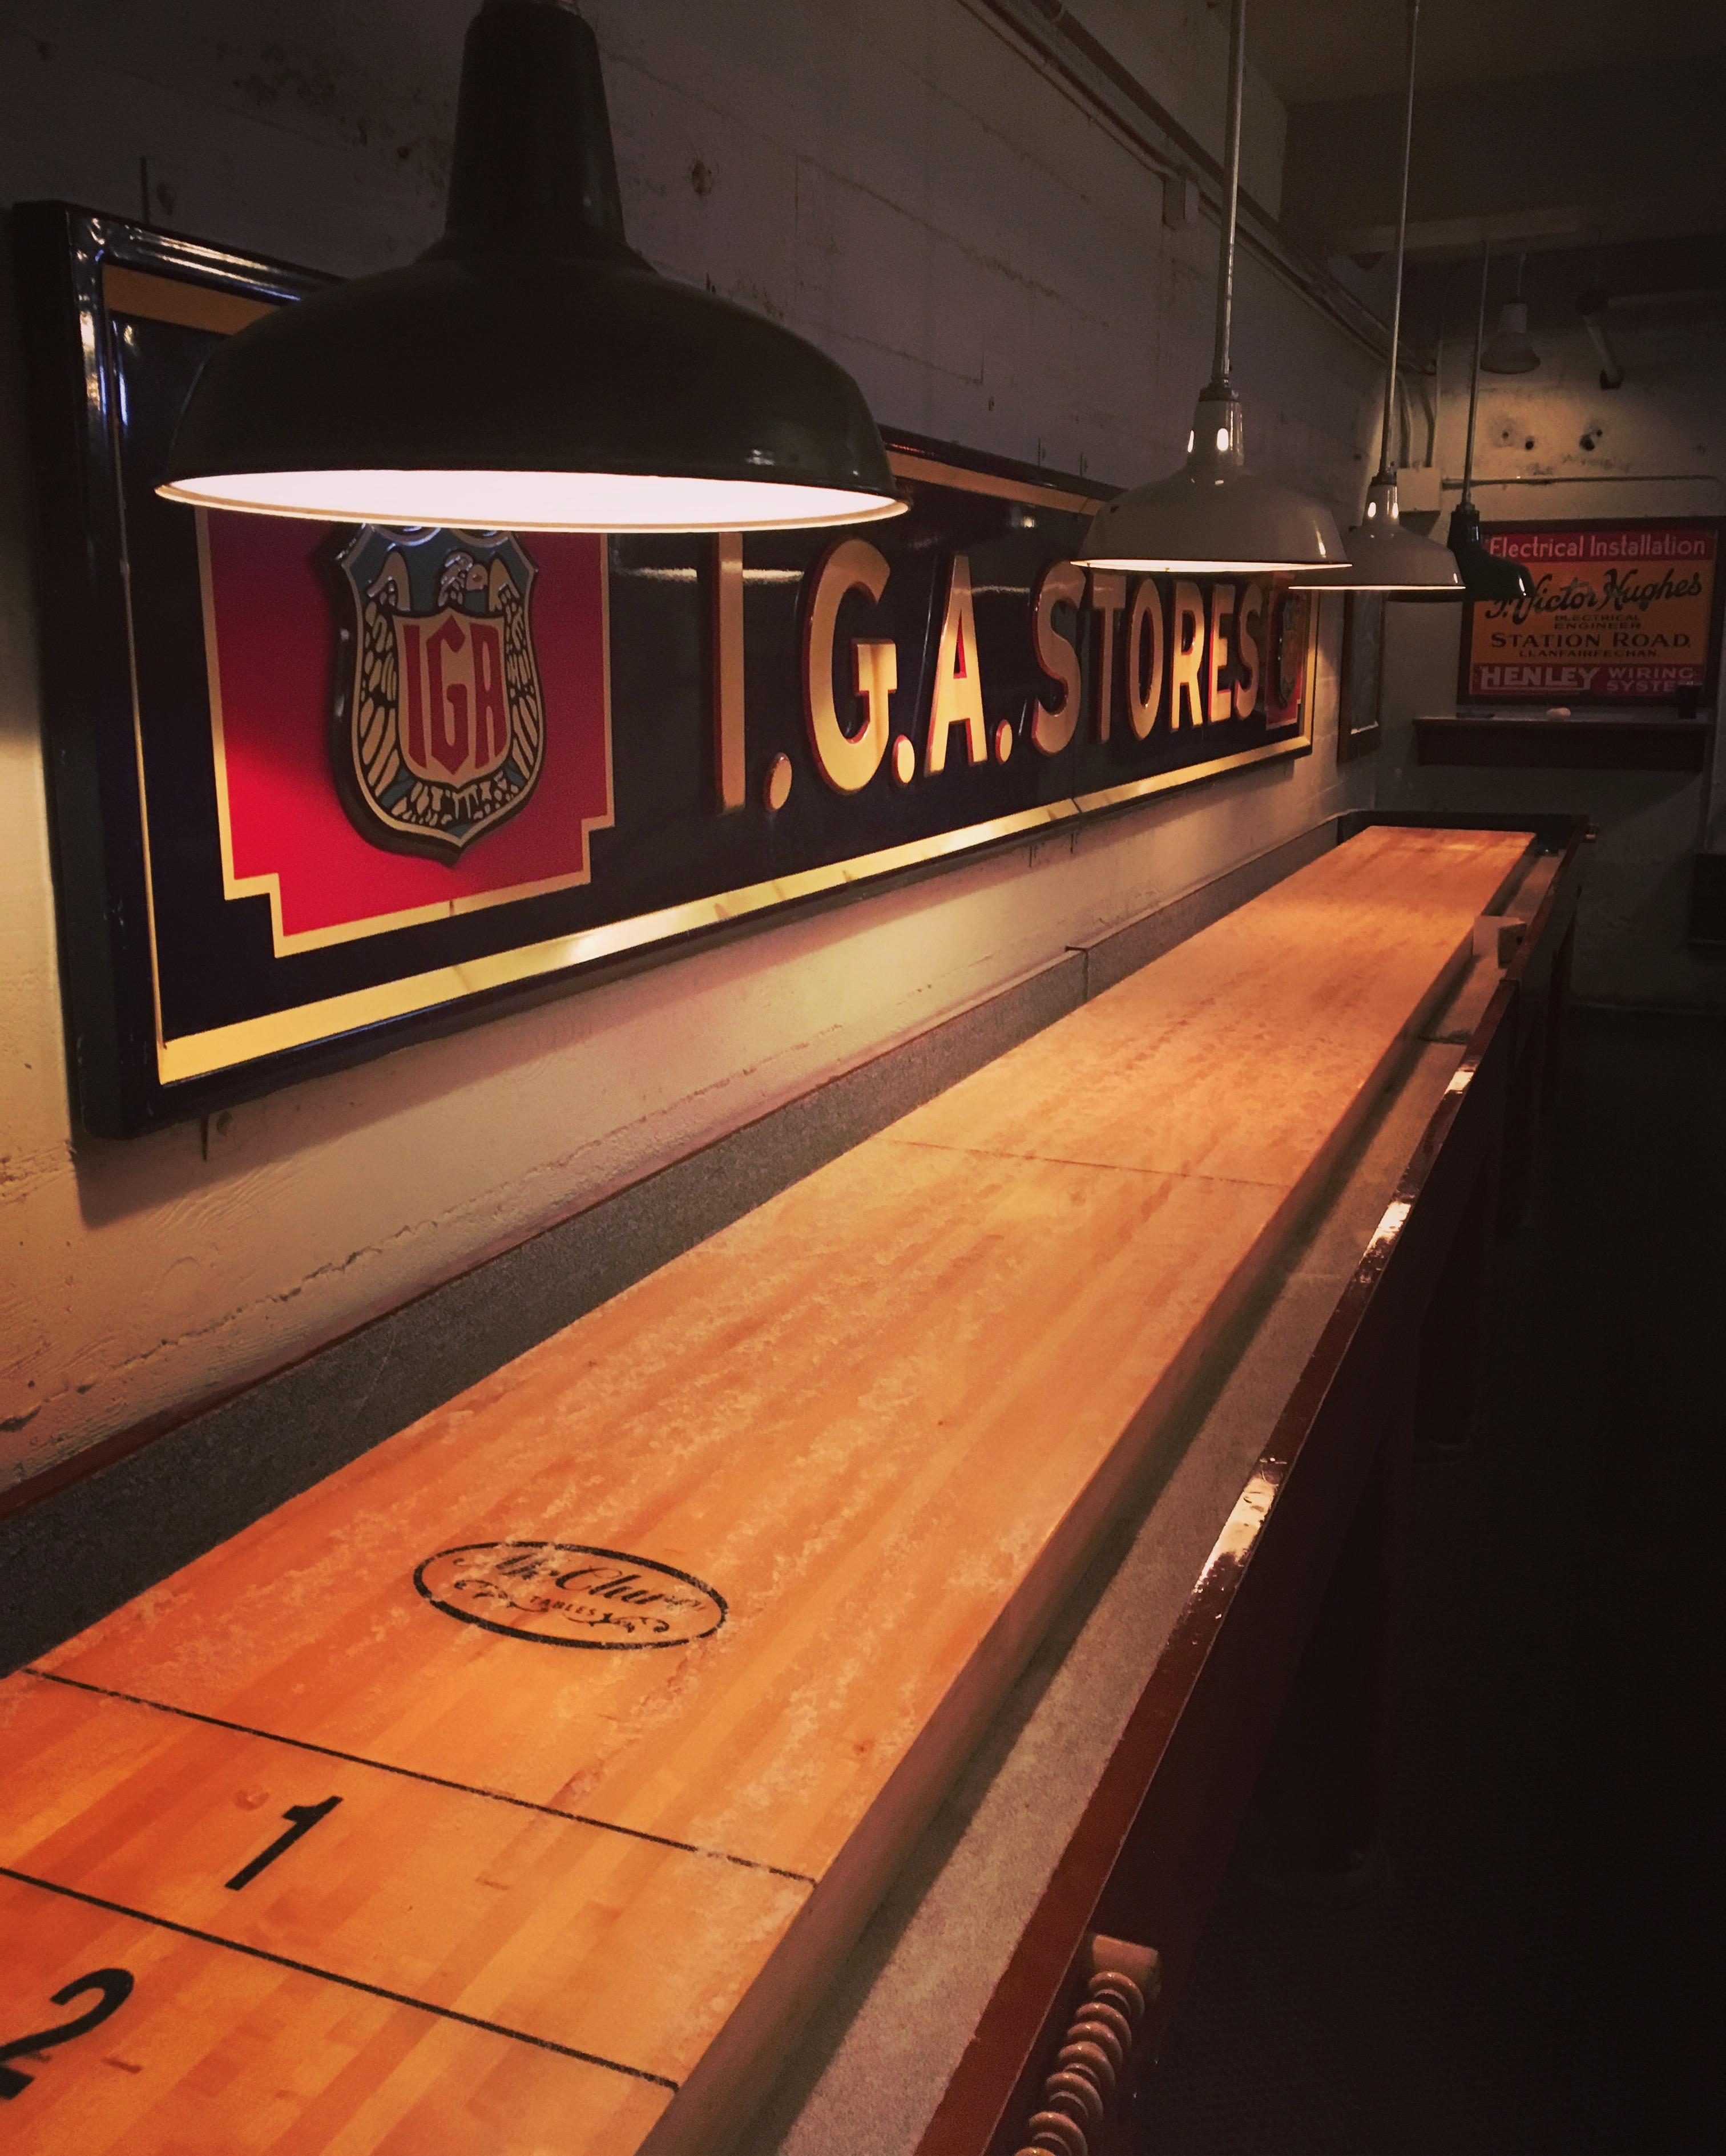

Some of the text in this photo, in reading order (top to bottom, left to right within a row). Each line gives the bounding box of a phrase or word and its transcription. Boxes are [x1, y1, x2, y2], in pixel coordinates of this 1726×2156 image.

[1490, 534, 1705, 558] Electrical Installation
[1596, 568, 1702, 612] Hughes
[1031, 559, 1258, 756] STORES
[1491, 632, 1600, 648] STATION
[403, 614, 507, 776] IGA
[1481, 667, 1694, 691] HENLEY WIRING
[225, 1795, 343, 1891] 1
[0, 1968, 135, 2100] 2
